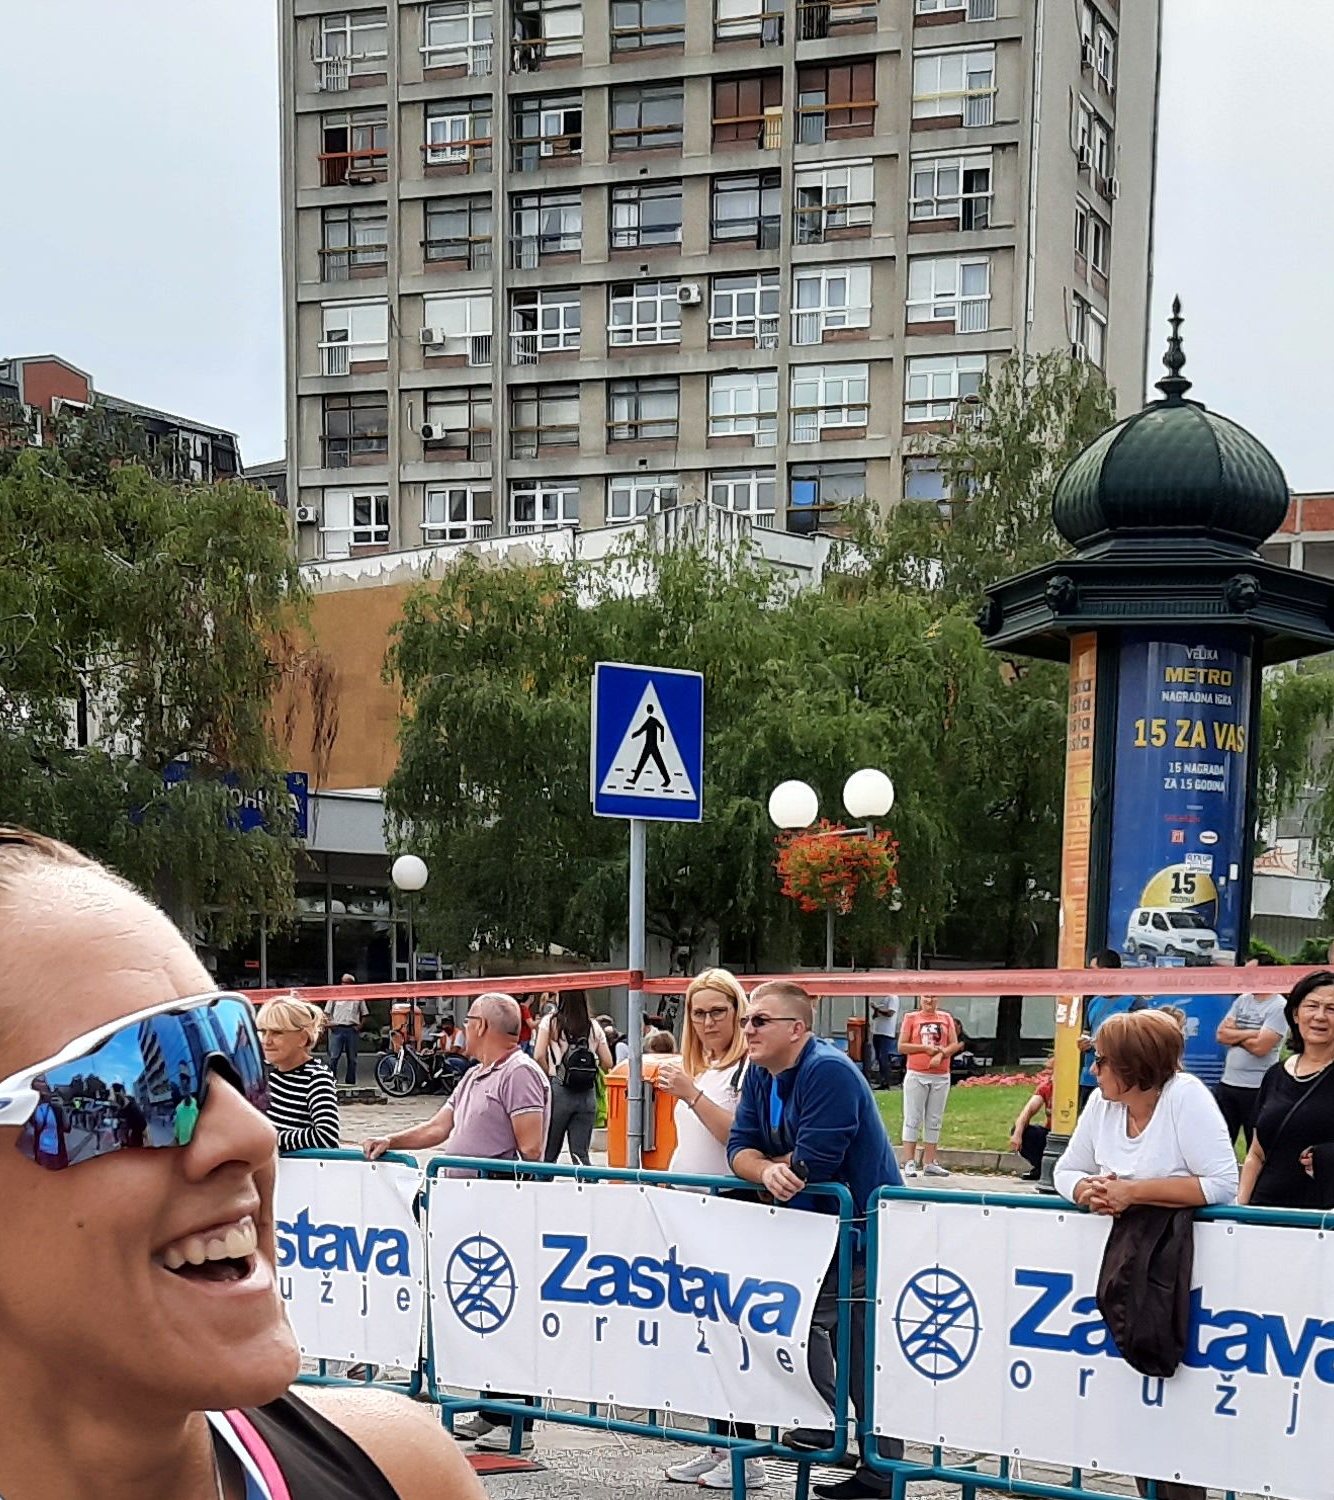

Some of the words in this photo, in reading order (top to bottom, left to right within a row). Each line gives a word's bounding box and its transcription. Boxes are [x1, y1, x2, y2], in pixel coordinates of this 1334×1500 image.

[1185, 648, 1218, 661] VELIKA
[1165, 666, 1233, 686] METRO
[1161, 691, 1213, 705] NAGRADNA
[1214, 693, 1232, 706] IGRA
[1133, 718, 1167, 748] 15
[1174, 719, 1207, 749] ZA
[1213, 721, 1245, 753] VAS
[1183, 763, 1224, 775] NAGRADA
[1163, 778, 1177, 790] ZA
[1180, 778, 1192, 790] 15
[1194, 779, 1226, 792] GODINA
[1171, 872, 1196, 895] 15
[275, 1206, 411, 1278] stava
[280, 1271, 411, 1316] užje
[540, 1232, 802, 1338] Zastava
